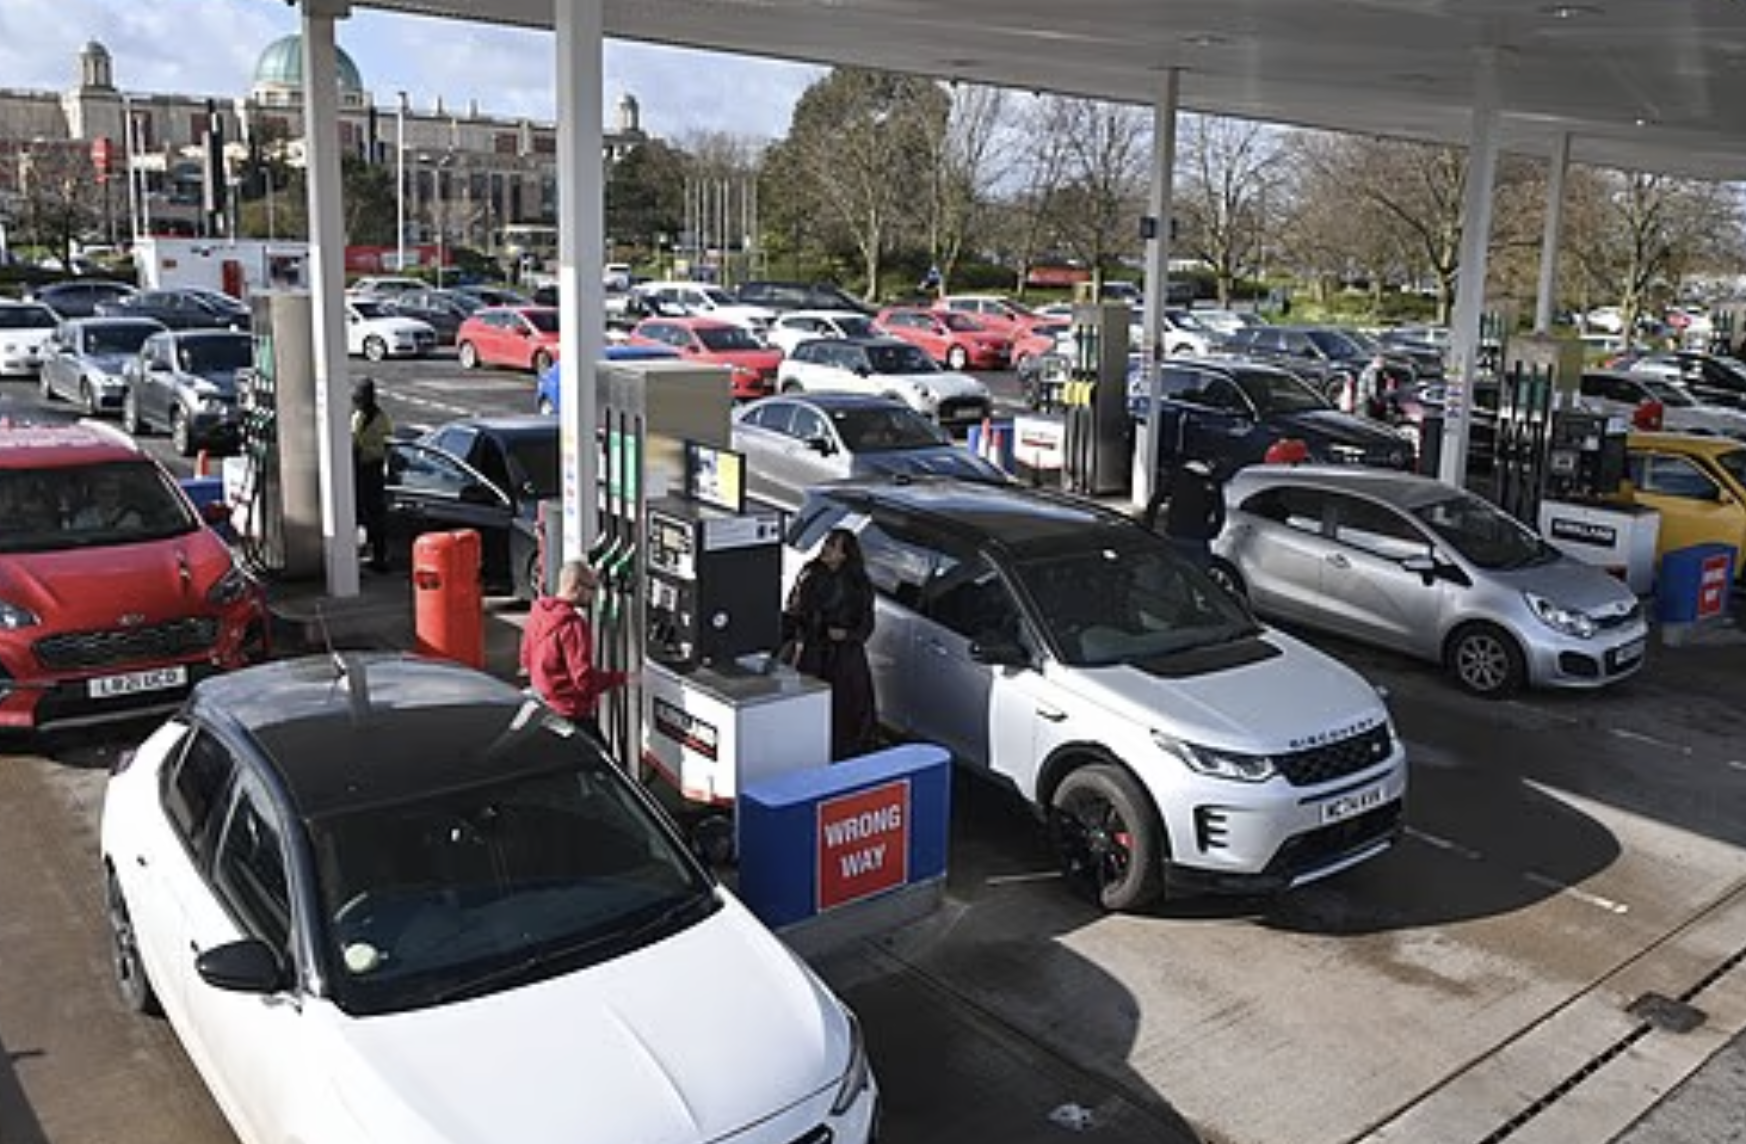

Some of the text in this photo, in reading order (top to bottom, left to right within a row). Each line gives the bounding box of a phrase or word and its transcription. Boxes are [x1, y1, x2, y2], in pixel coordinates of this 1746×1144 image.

[1289, 718, 1376, 749] DISCOVERY
[824, 804, 901, 849] WRONG
[841, 843, 887, 877] WAY
